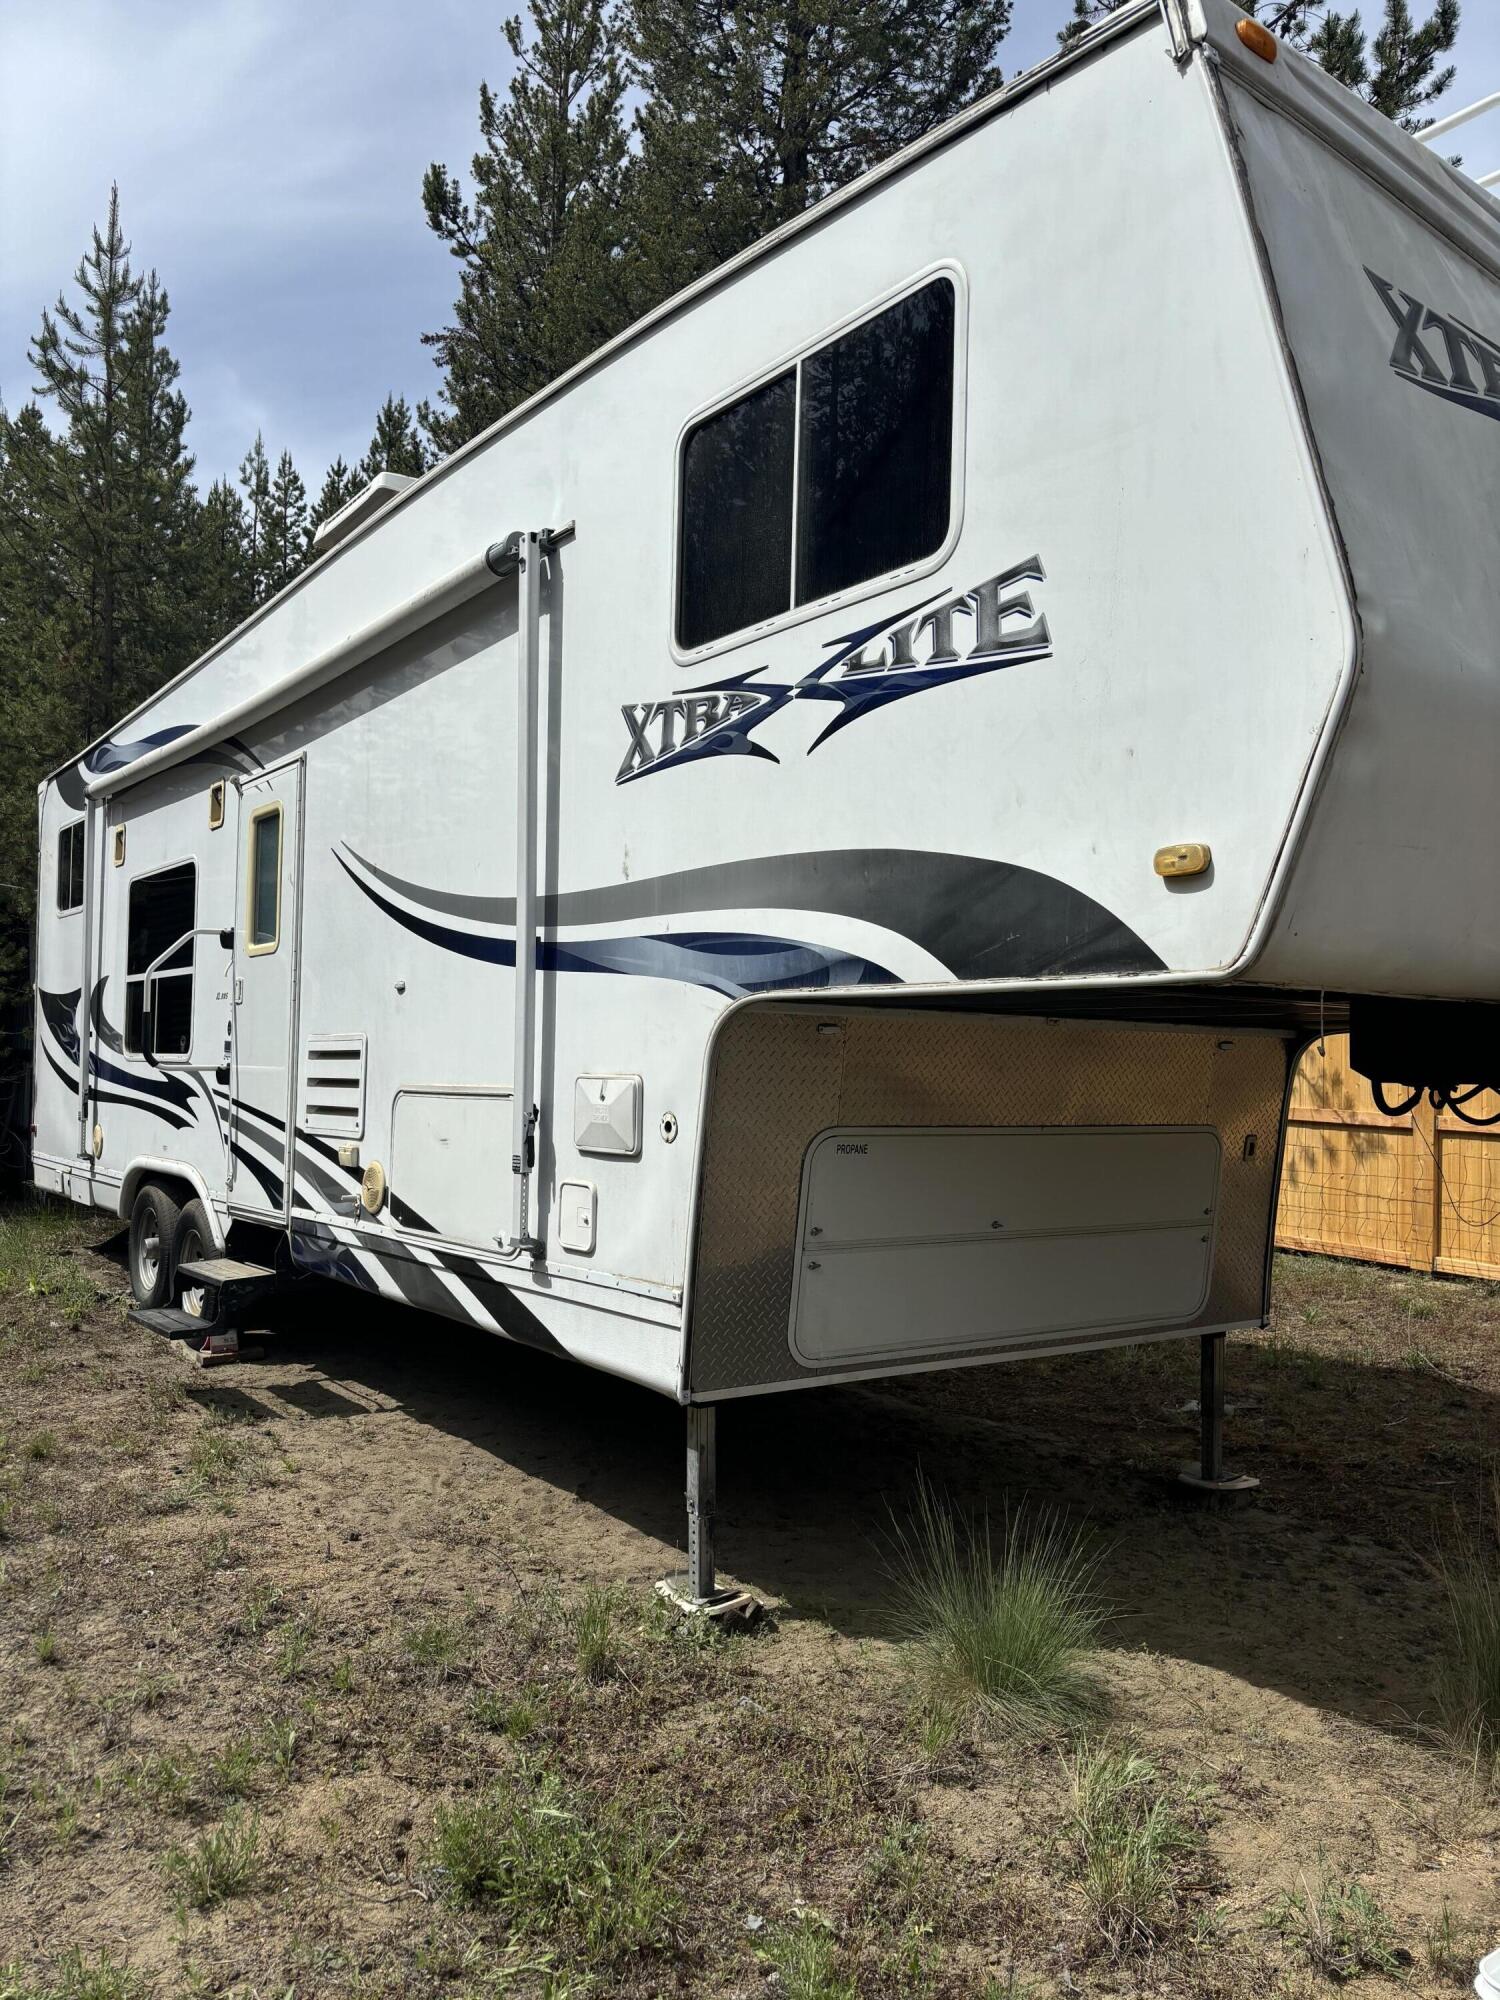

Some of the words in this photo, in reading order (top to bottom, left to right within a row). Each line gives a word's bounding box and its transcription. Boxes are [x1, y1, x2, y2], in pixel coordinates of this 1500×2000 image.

[615, 692, 762, 783] XTRA
[841, 553, 1053, 679] LITE
[836, 1143, 869, 1155] PROPANE
